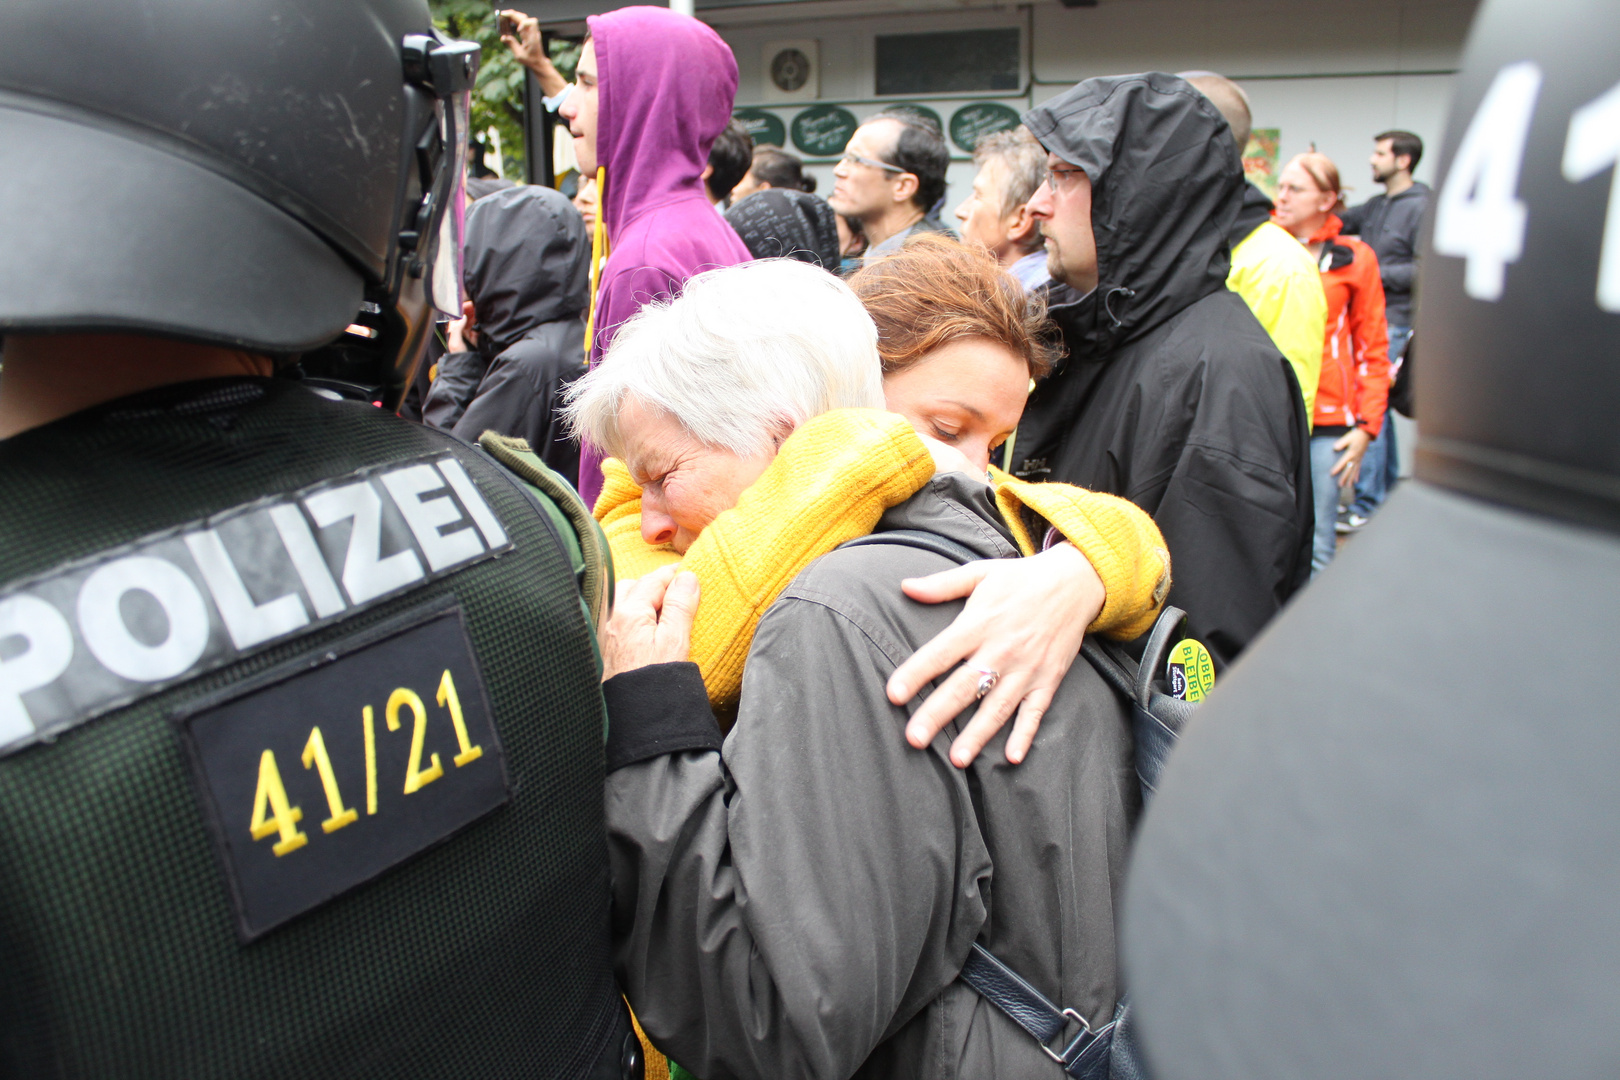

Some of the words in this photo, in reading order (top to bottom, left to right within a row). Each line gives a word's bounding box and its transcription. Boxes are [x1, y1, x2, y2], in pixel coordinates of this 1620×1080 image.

[0, 458, 507, 750] POLIZEI
[1200, 653, 1213, 692] OBEN
[250, 669, 482, 857] 41/21
